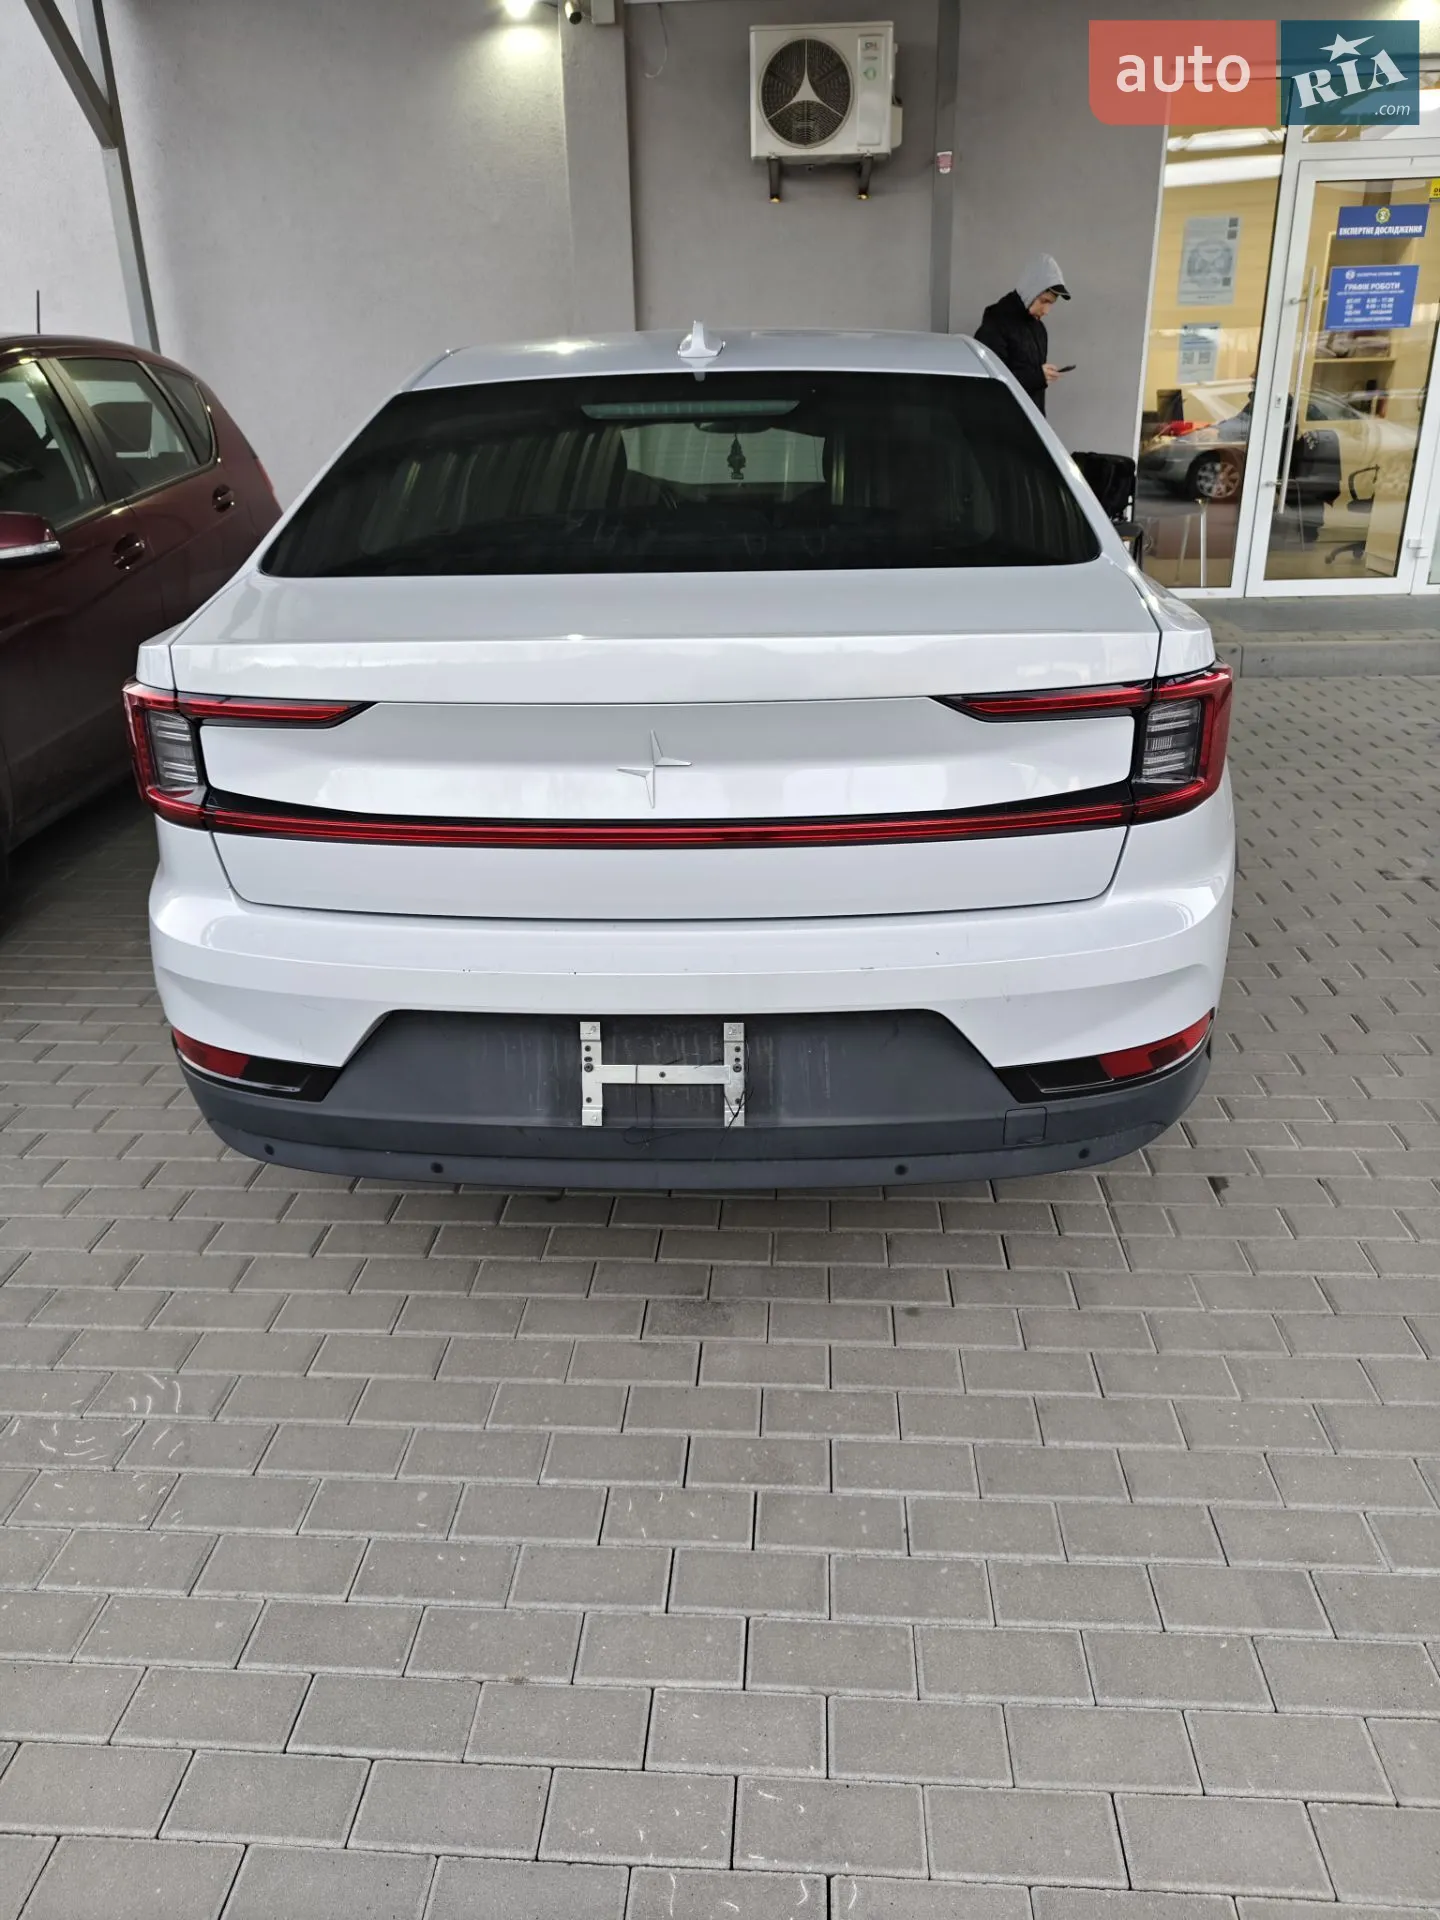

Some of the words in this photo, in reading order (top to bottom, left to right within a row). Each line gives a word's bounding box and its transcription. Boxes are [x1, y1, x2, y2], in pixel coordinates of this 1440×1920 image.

[1339, 226, 1374, 236] ЕКСПЕРТНЕ
[1374, 225, 1423, 236] ДОСЛІДЖЕННЯ
[1370, 282, 1400, 290] РОБОТИ
